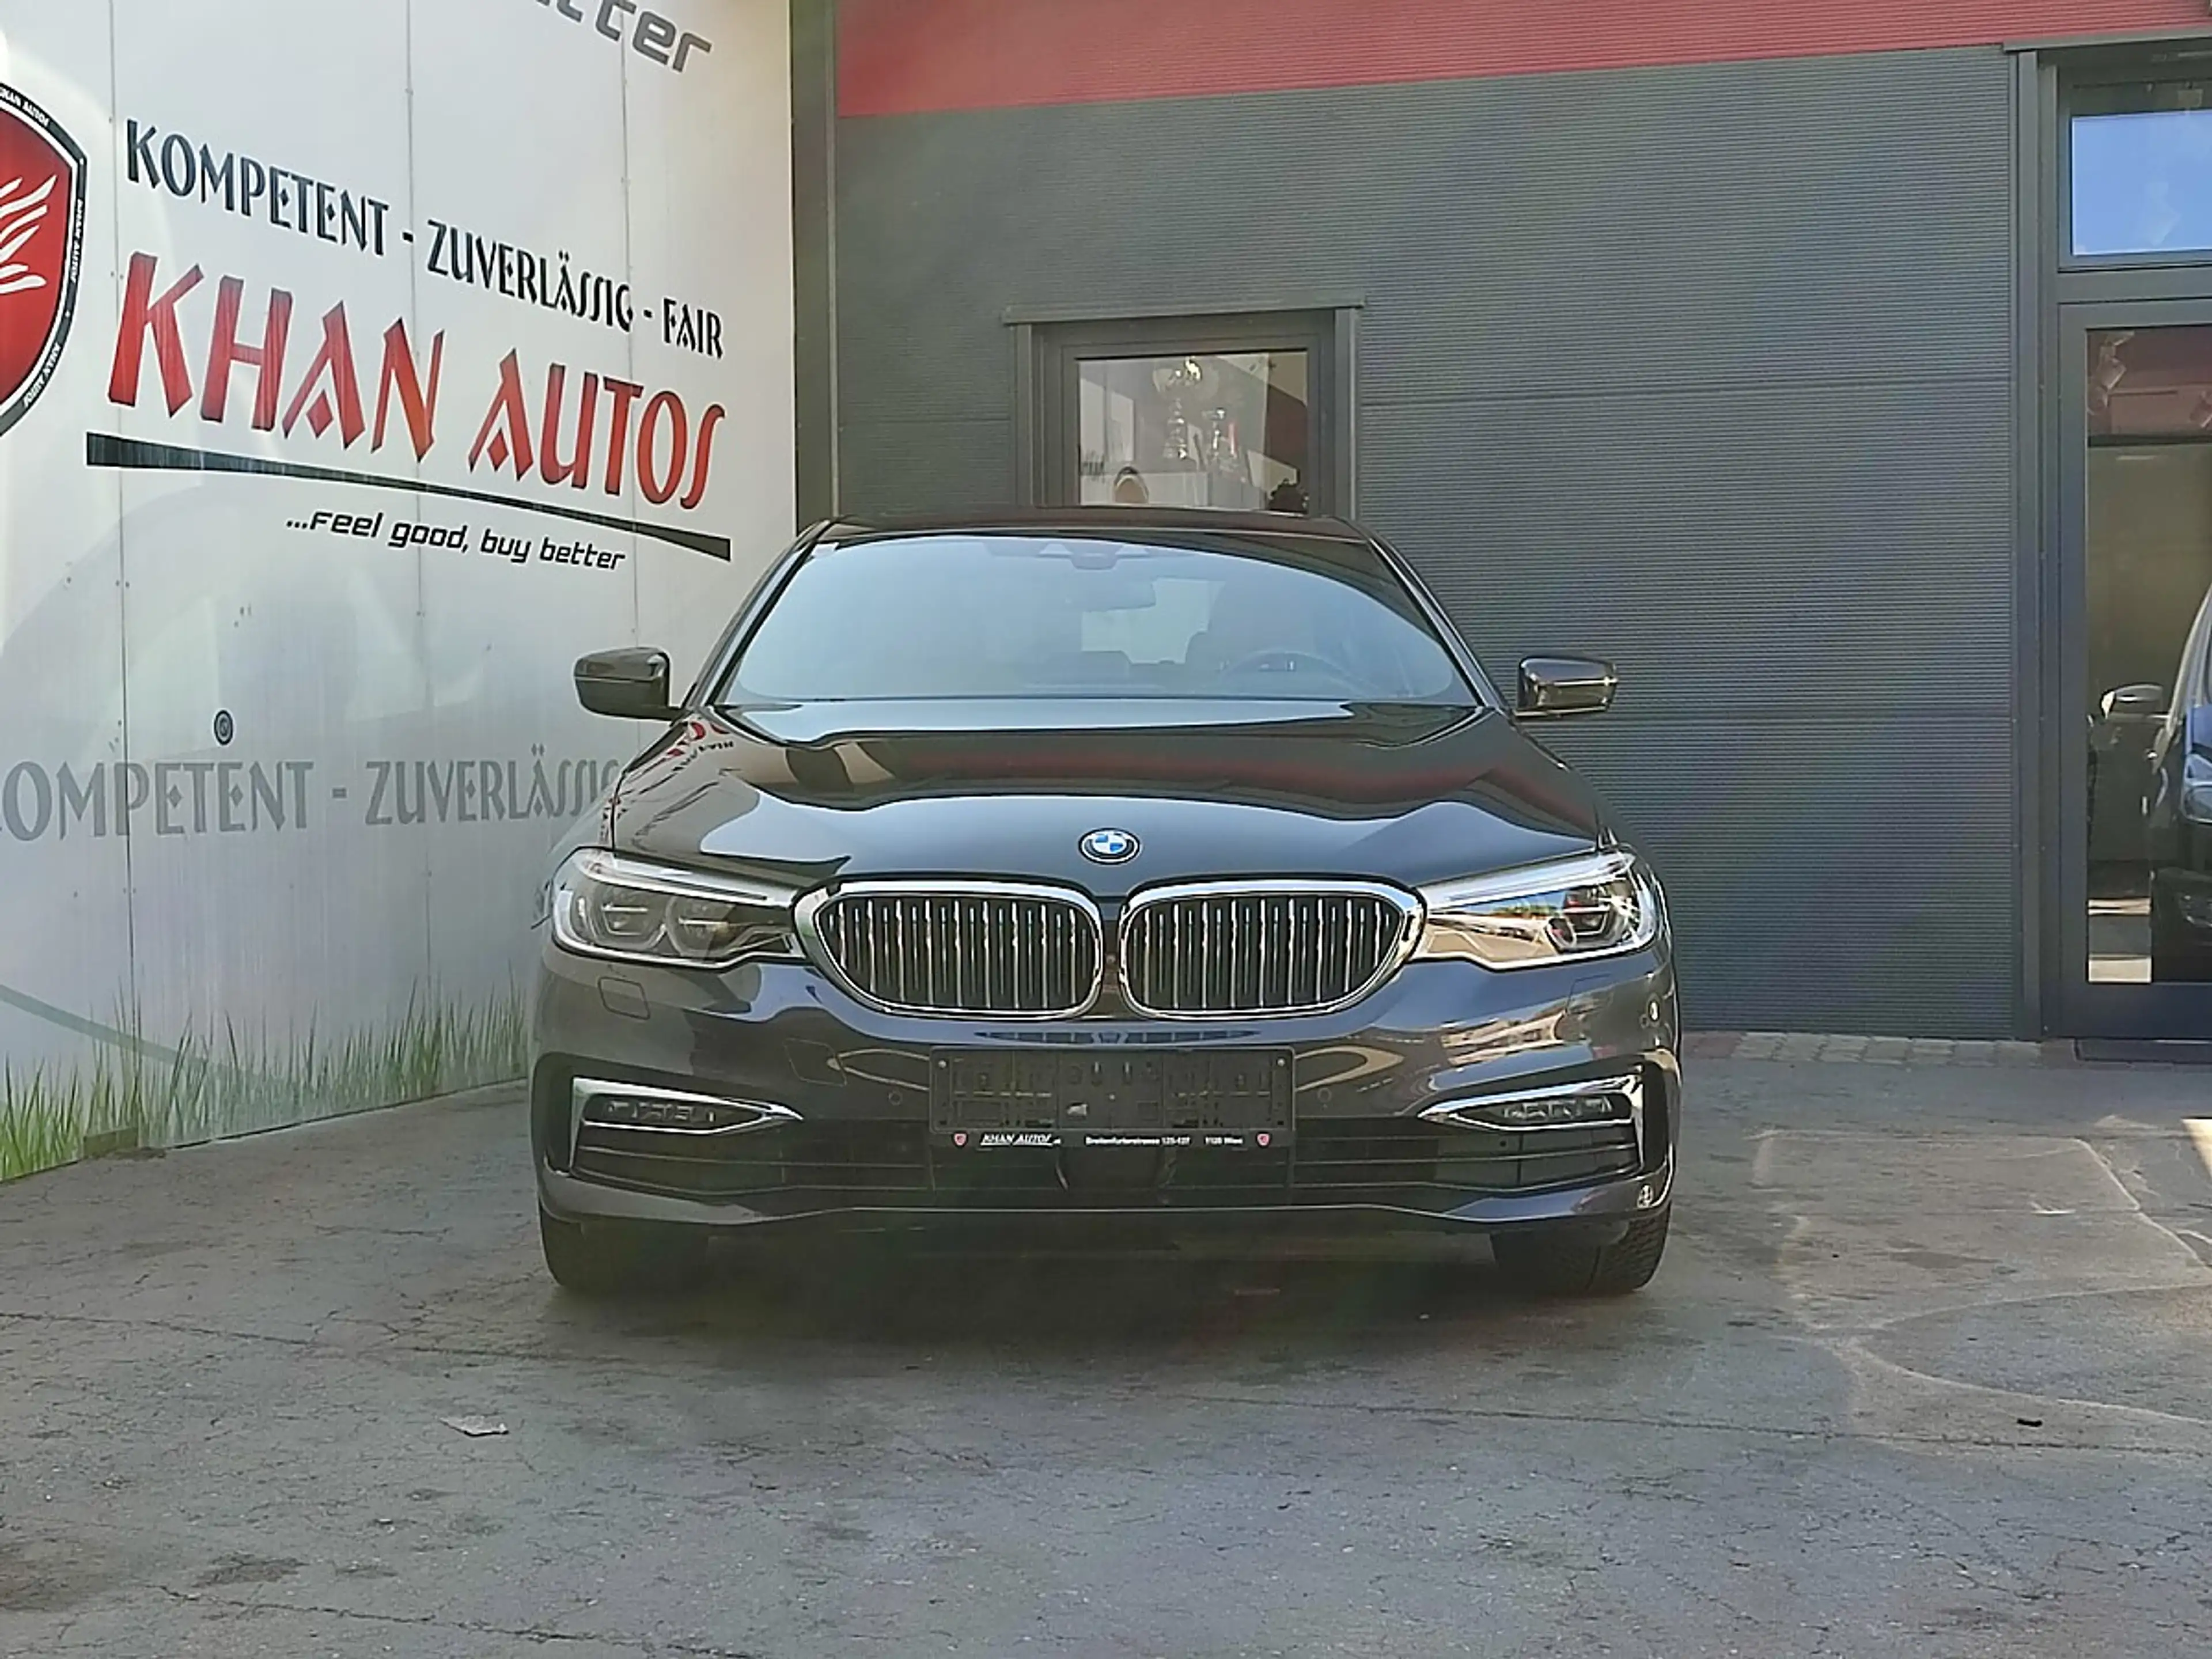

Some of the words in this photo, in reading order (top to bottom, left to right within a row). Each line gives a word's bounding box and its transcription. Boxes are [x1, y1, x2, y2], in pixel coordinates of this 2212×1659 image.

[127, 119, 389, 257] KOMPETENT
[427, 219, 634, 333] ZUVERLÄSSIG
[664, 297, 724, 359] FAIR
[108, 252, 445, 463] KHAN
[468, 349, 725, 510] AUTOS
[388, 522, 469, 554] good,
[480, 528, 532, 564] buy
[539, 536, 626, 570] better
[0, 760, 315, 842] OMPETENT
